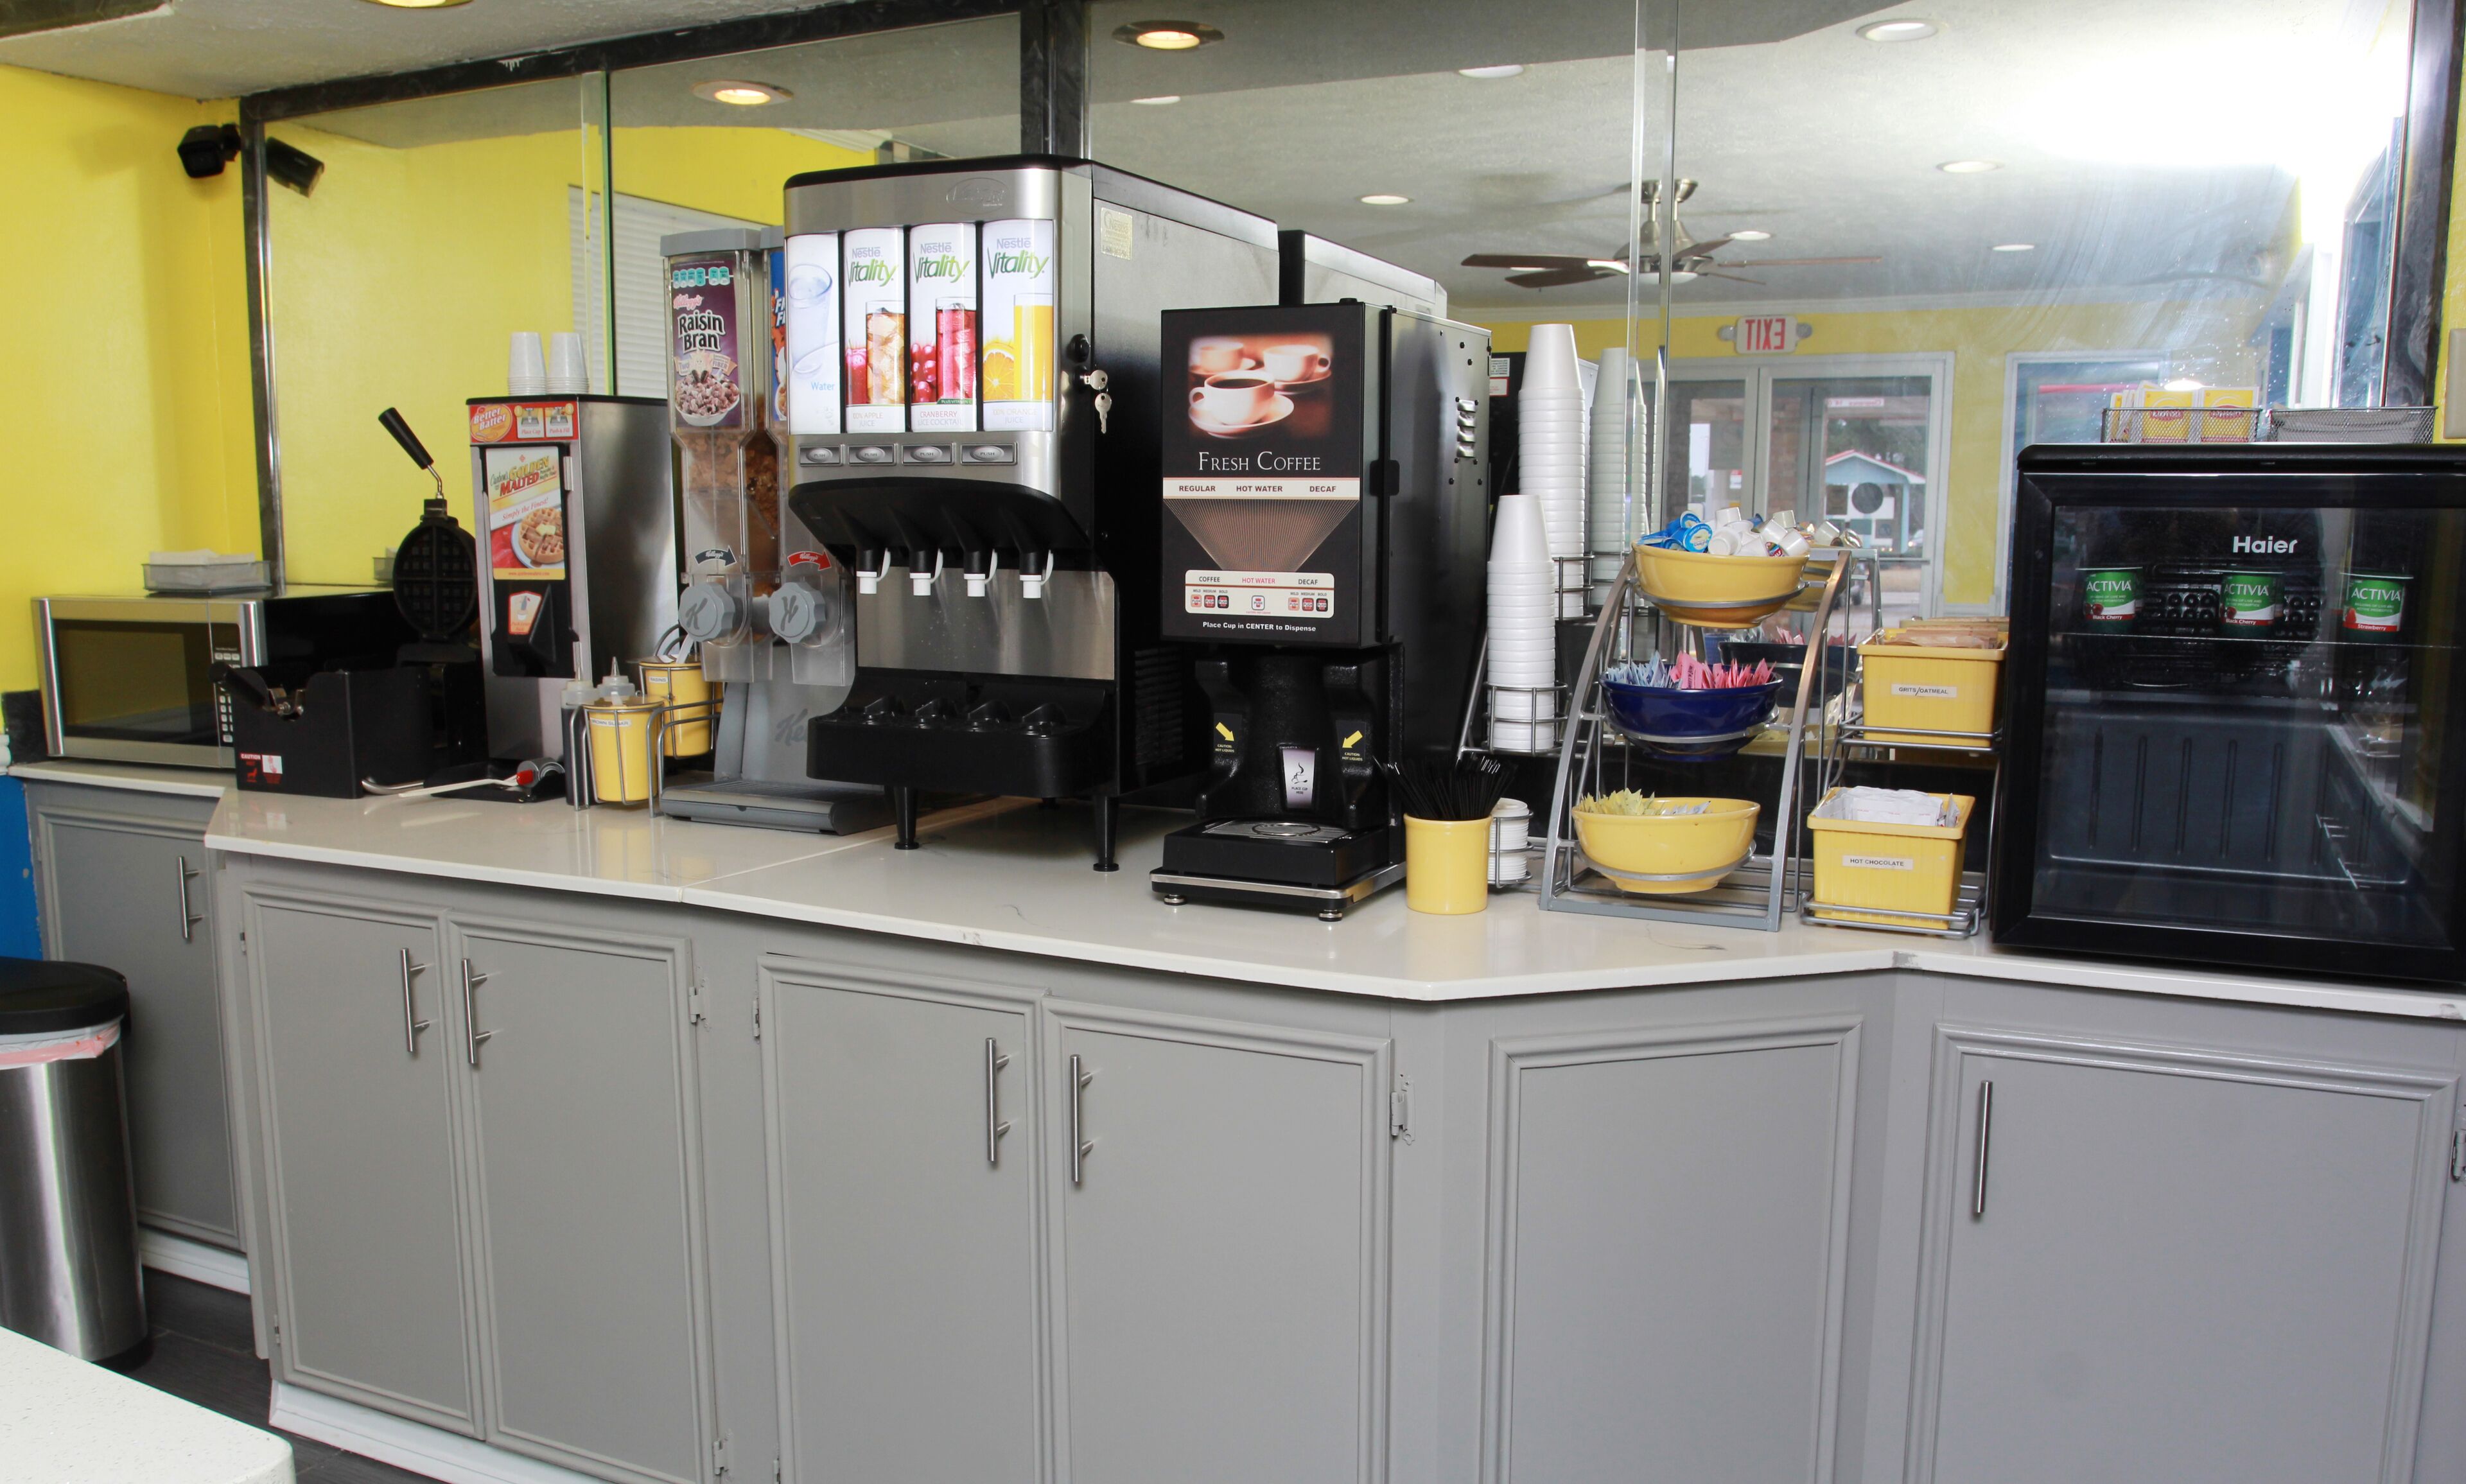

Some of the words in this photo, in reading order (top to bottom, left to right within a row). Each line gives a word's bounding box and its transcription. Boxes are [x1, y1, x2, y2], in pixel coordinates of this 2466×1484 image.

[846, 256, 899, 288] Vitality
[913, 251, 970, 284] Vitality
[986, 247, 1049, 280] Vitality
[672, 293, 704, 310] Kellogg's
[678, 309, 726, 336] Raisin
[683, 331, 721, 353] Bran
[811, 381, 834, 391] Water
[473, 407, 501, 425] Better
[479, 414, 507, 431] Batter
[1005, 416, 1023, 424] JUICE
[509, 457, 550, 482] GOLDEN
[500, 471, 540, 497] MALTED
[502, 509, 520, 519] Simply
[2233, 536, 2298, 554] Haier
[2086, 580, 2132, 591] ACTIVIA
[2224, 583, 2269, 596] ACTIVIA
[2351, 587, 2400, 601] ACTIVIA
[1898, 686, 1948, 696] GRITS/OATMEAL
